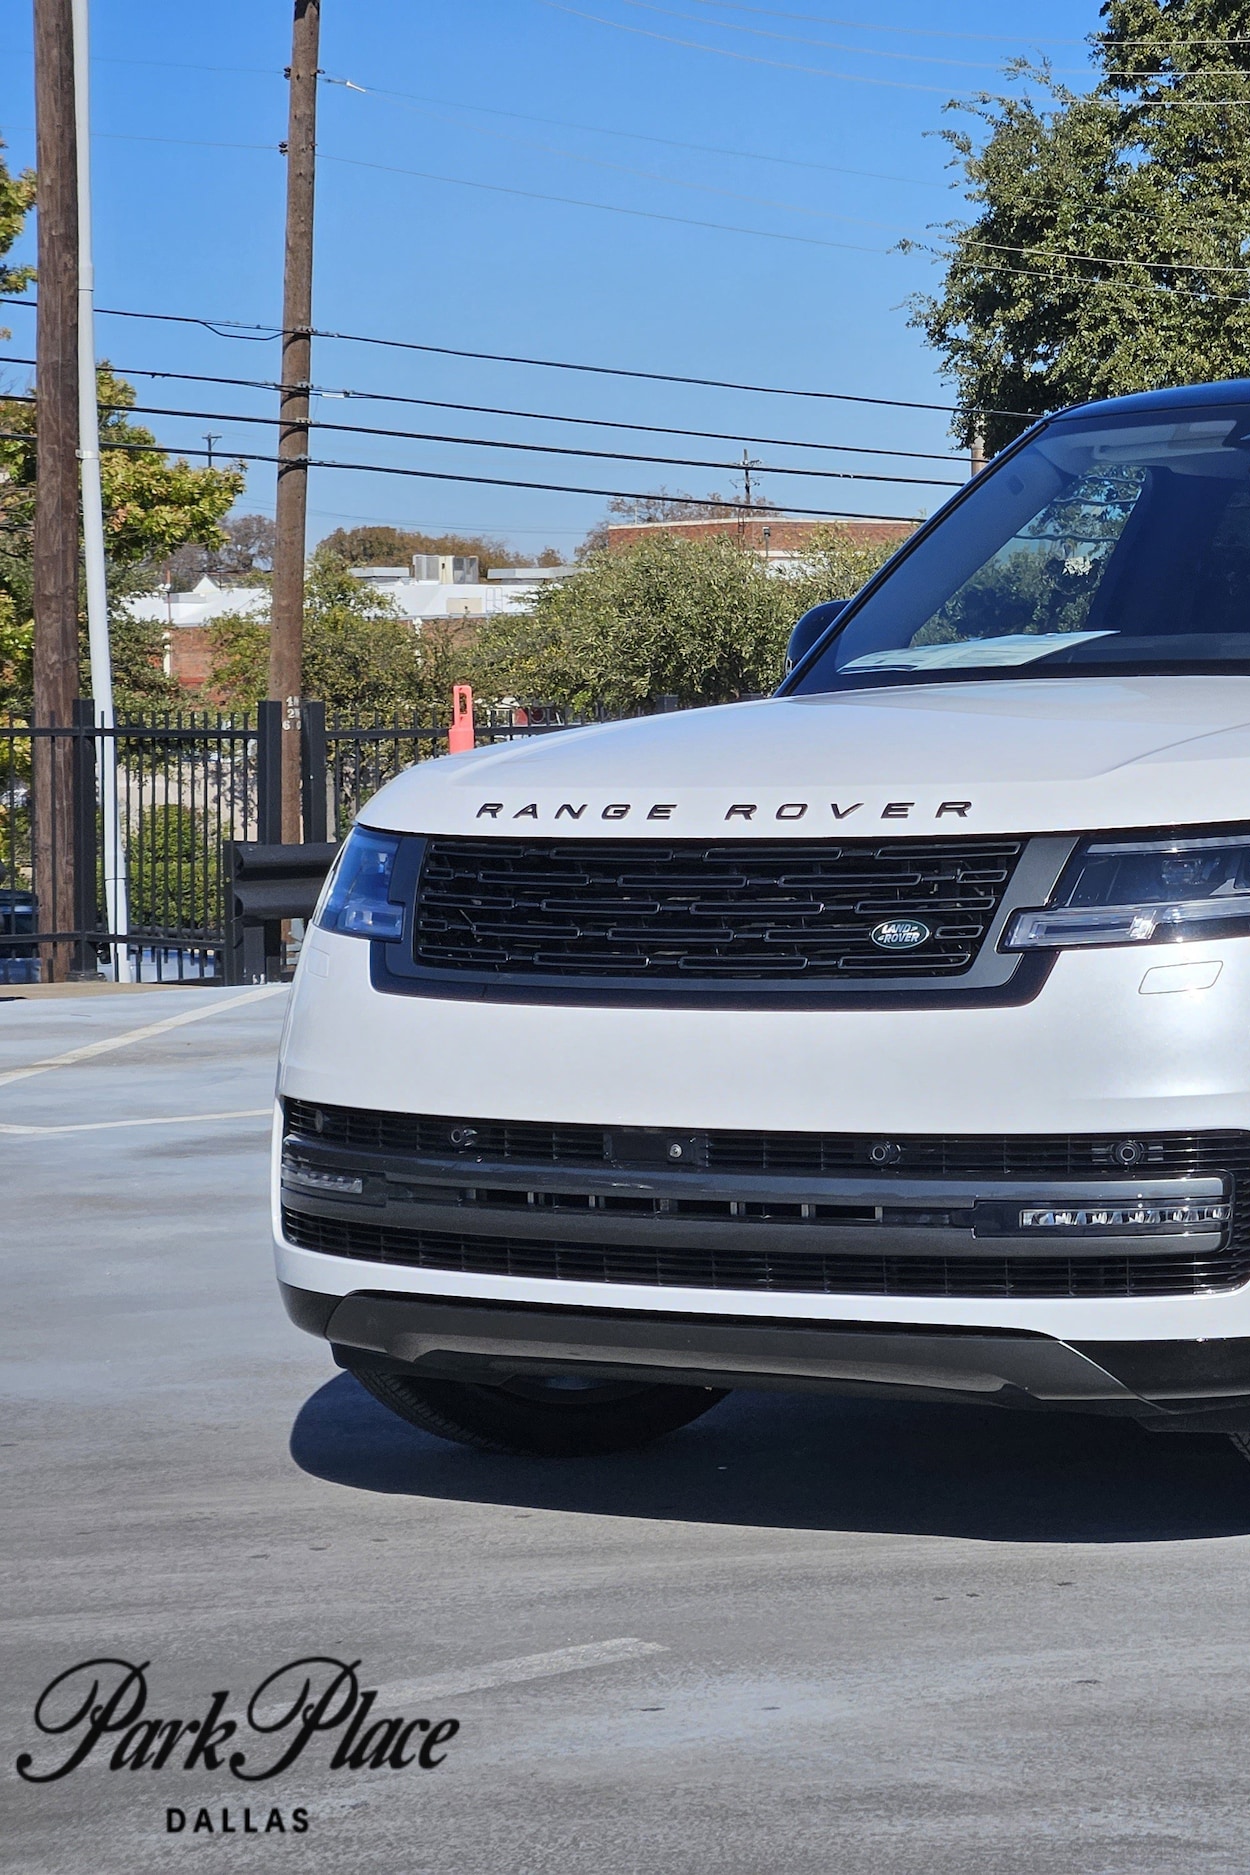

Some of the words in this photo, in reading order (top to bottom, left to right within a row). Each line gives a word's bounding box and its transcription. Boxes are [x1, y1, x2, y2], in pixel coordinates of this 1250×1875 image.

[475, 803, 678, 821] RANGE
[724, 801, 973, 821] ROVER
[881, 923, 912, 934] LAND
[883, 932, 920, 943] ROVER
